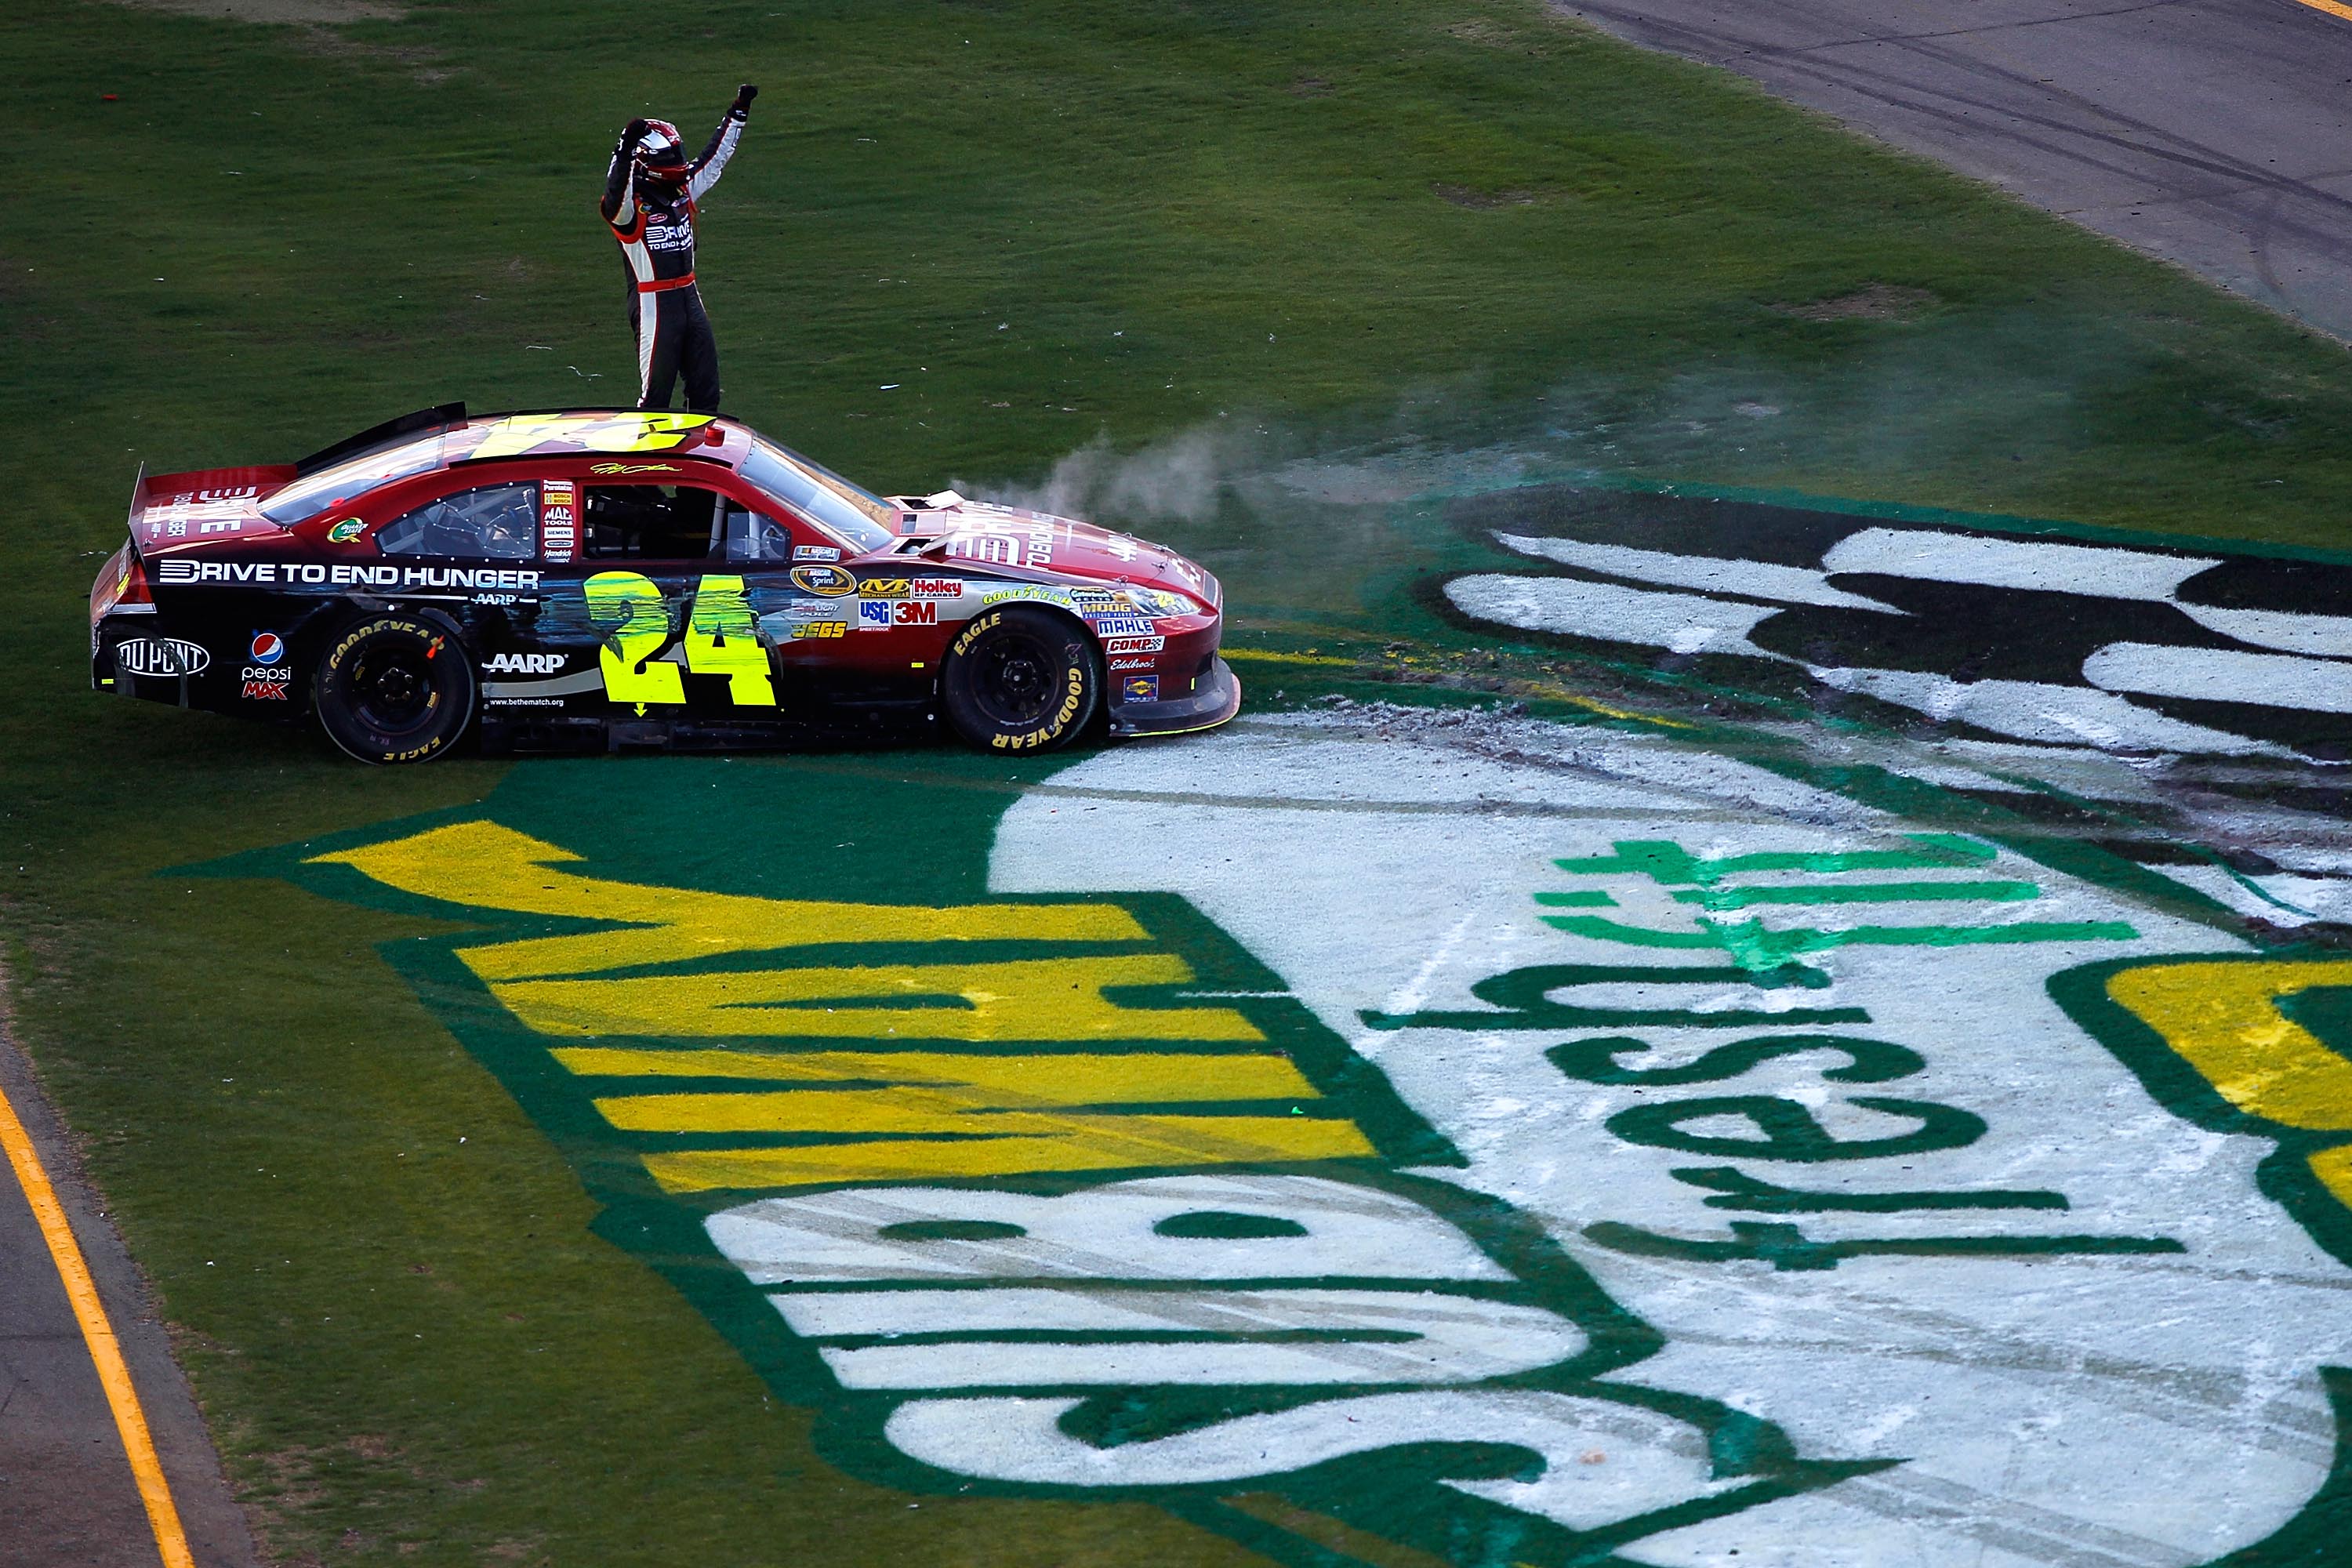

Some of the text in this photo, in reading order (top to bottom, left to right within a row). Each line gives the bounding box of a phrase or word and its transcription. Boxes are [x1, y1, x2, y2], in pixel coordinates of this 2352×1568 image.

[544, 506, 573, 520] MAC
[543, 550, 572, 558] Hendrick
[159, 559, 539, 590] DRIVE TO END HUNGER
[812, 577, 833, 588] Sprint
[914, 580, 961, 597] Holley
[860, 601, 936, 624] USG 3M
[1083, 604, 1131, 612] MOOG
[791, 622, 848, 638] JEGS
[953, 612, 1001, 657] EAGLE
[1099, 620, 1152, 633] MAHLE
[583, 571, 777, 706] 24
[1110, 639, 1151, 651] COMP
[481, 653, 565, 673] AARP
[1110, 658, 1155, 670] Edelbrock
[241, 666, 291, 681] pepsi
[241, 681, 289, 700] MAX
[490, 699, 564, 707] www.bethematch.org
[992, 668, 1083, 749] GOODYEAR
[1358, 963, 2187, 1272] fresh
[304, 819, 1770, 1533] SUBWAY
